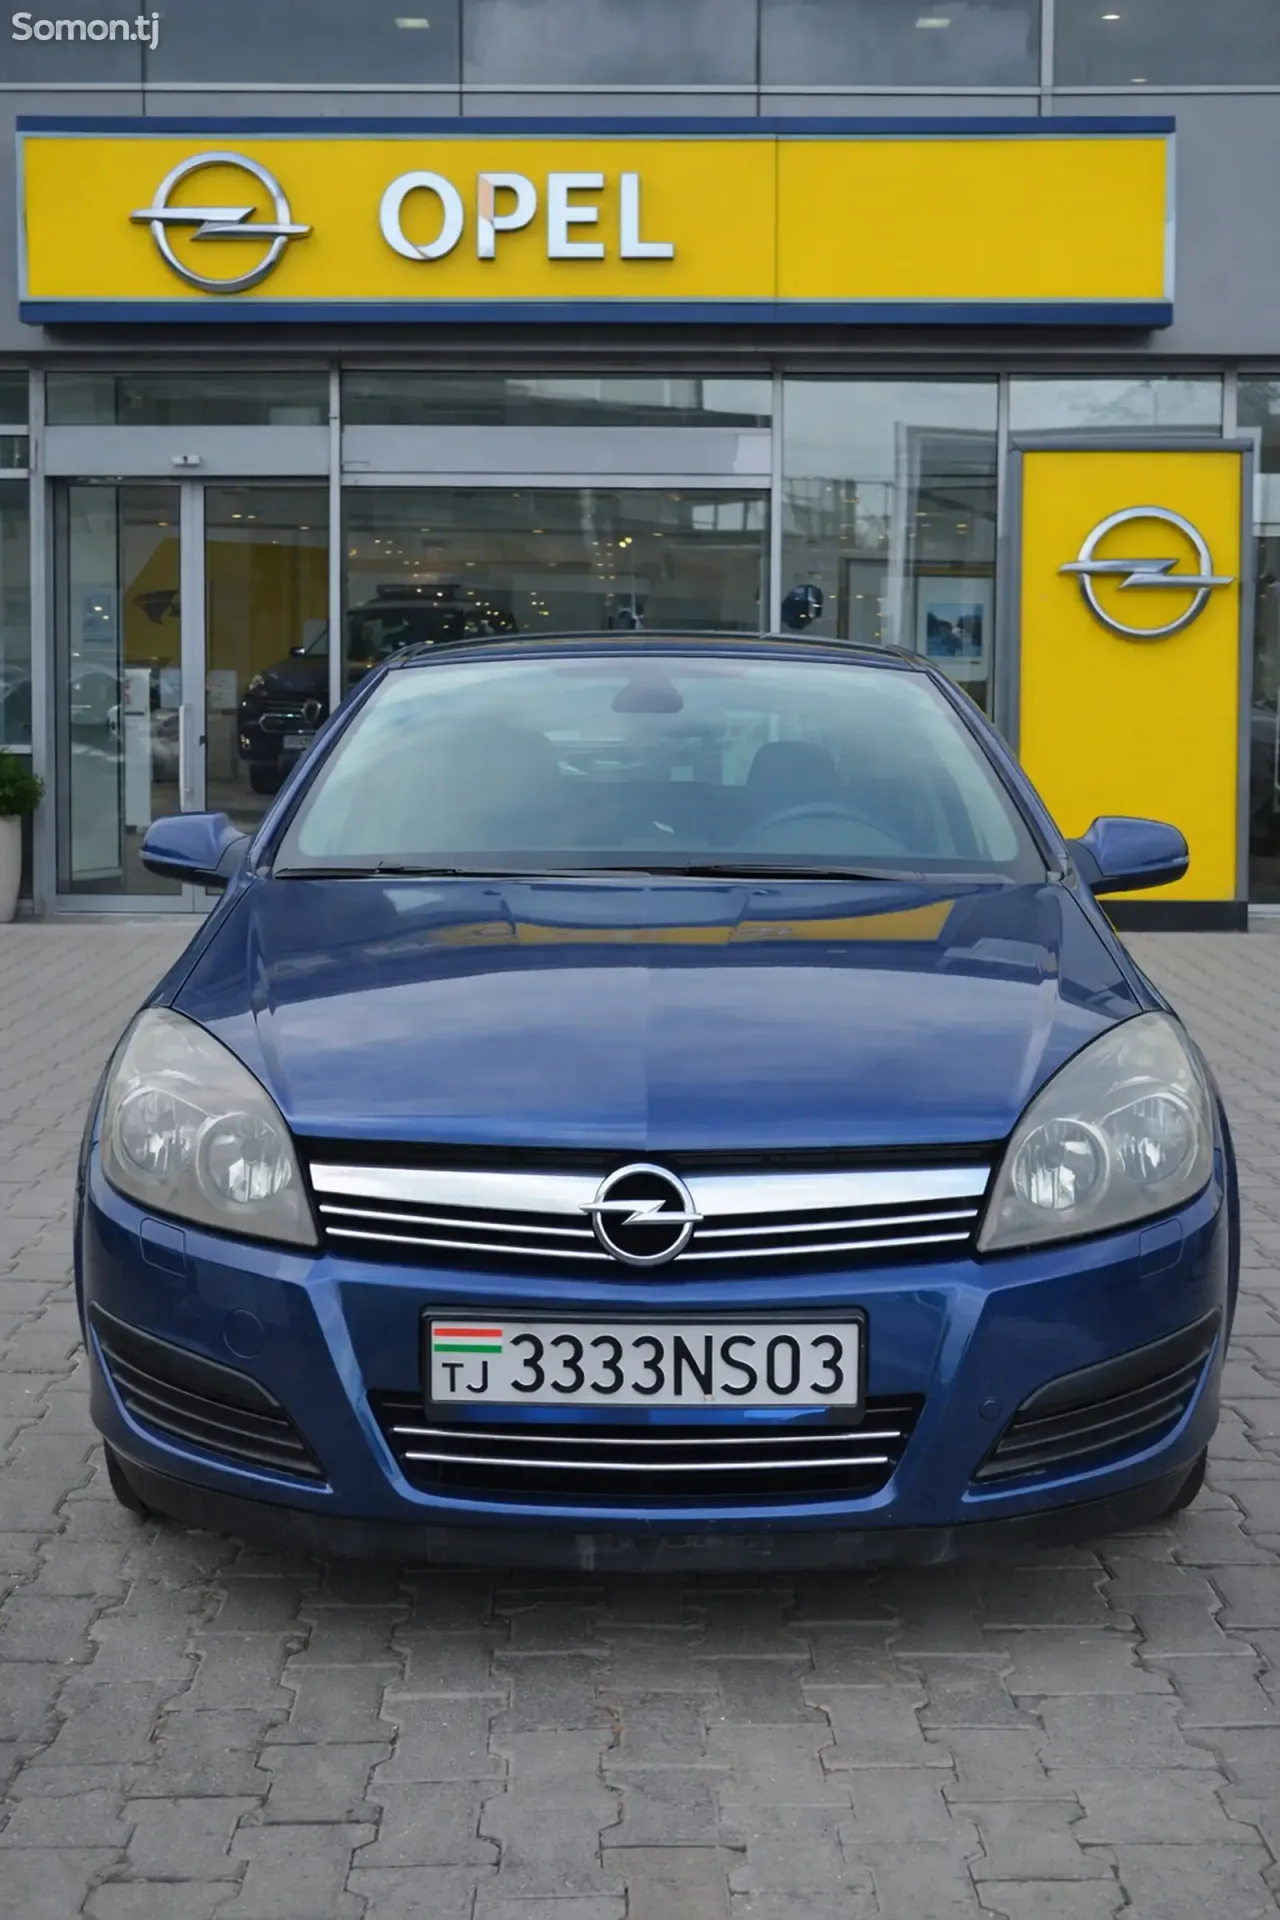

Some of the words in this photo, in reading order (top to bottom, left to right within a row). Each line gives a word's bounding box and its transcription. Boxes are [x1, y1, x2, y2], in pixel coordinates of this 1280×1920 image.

[379, 170, 675, 260] OPEL
[441, 1361, 489, 1393] TJ
[510, 1333, 844, 1396] 3333NS03
